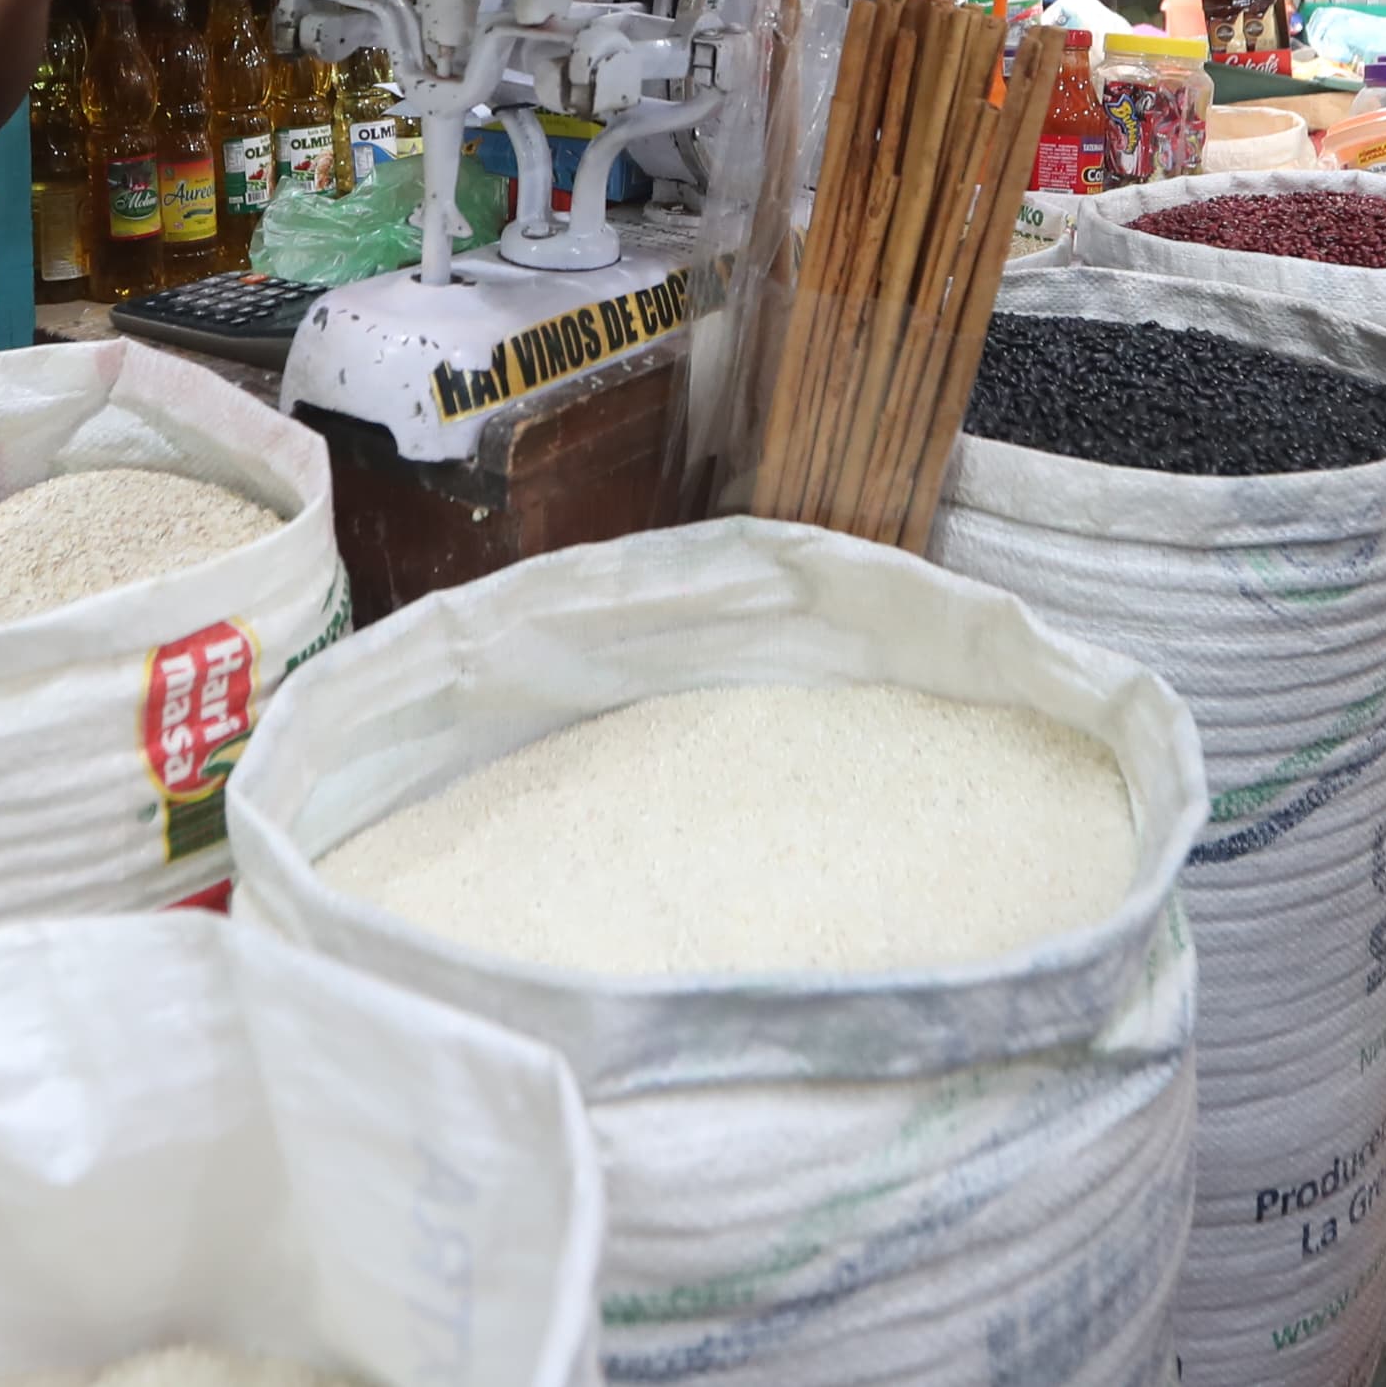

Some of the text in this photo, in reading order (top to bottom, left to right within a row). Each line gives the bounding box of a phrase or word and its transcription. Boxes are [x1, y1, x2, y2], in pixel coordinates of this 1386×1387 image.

[244, 143, 271, 161] OLM
[290, 135, 333, 151] OLMEC
[433, 293, 640, 418] HAY VINOS DE
[160, 652, 199, 787] masa
[200, 637, 243, 744] Hari
[1300, 1219, 1338, 1260] La
